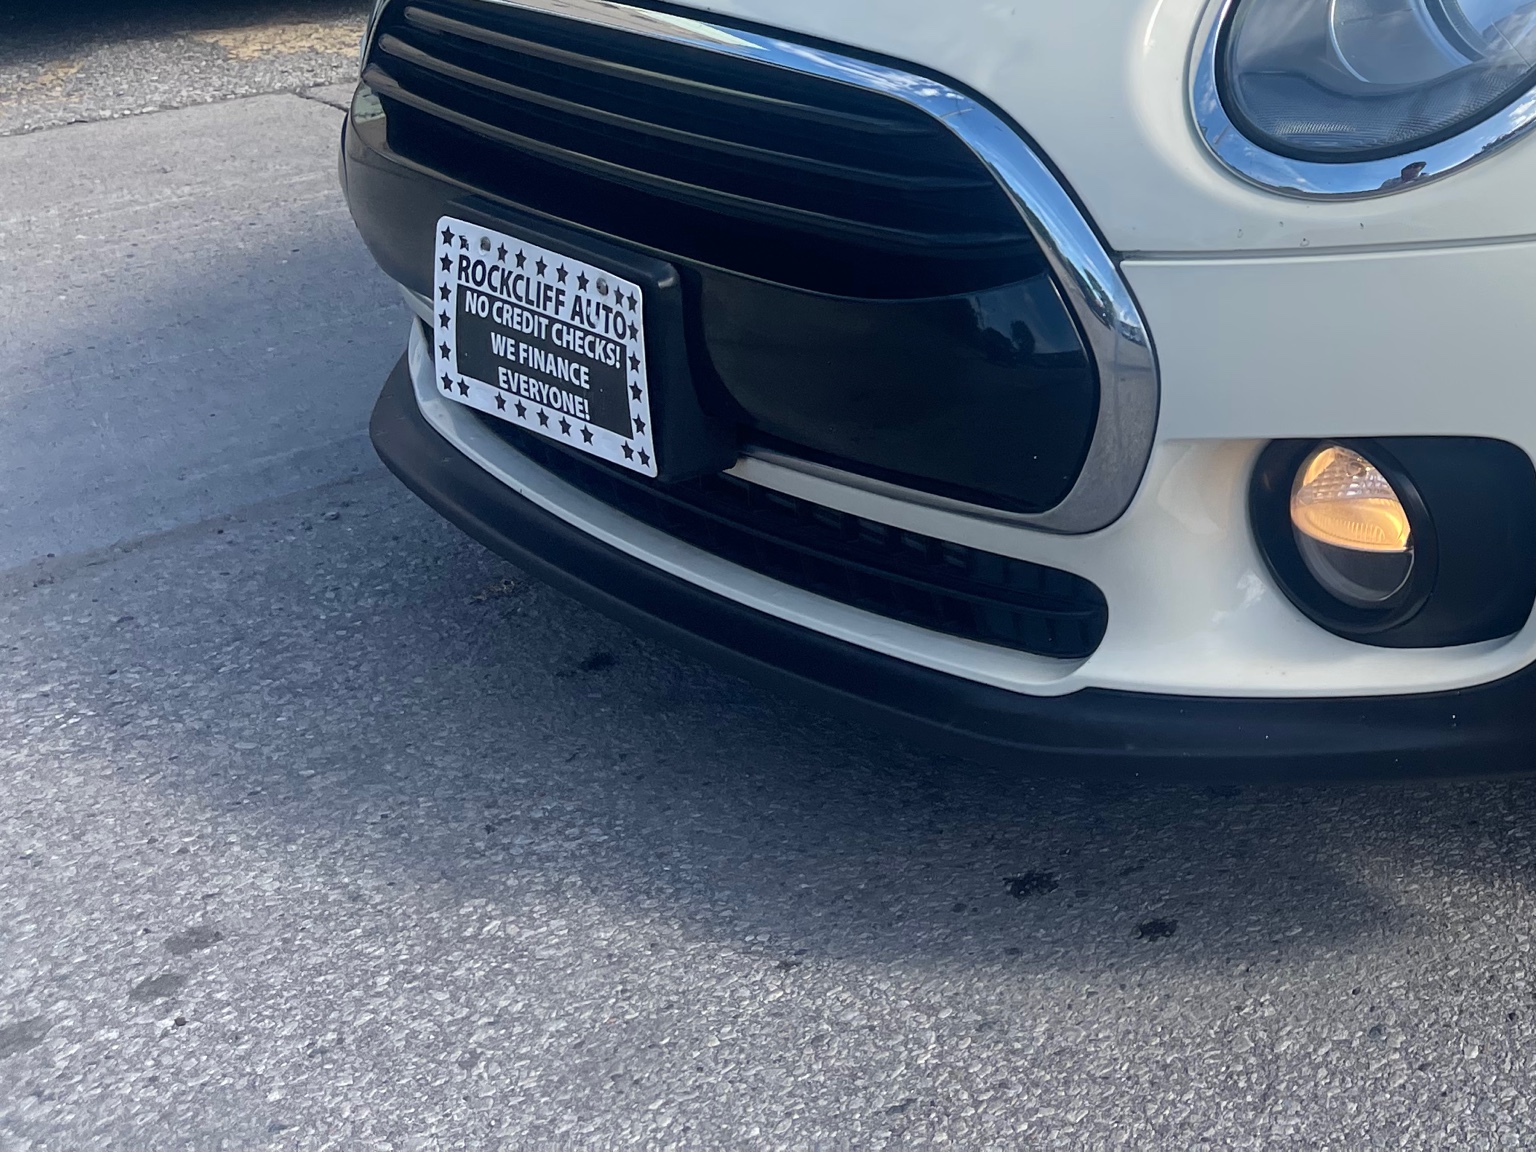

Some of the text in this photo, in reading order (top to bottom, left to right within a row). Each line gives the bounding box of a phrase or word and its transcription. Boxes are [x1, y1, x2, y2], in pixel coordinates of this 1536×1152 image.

[457, 254, 627, 340] ROCKCLIFF AUTO
[465, 290, 622, 369] NO CREDIT CHECKS!
[490, 331, 590, 389] WE FINANCE
[498, 366, 591, 421] EVERYONE!
